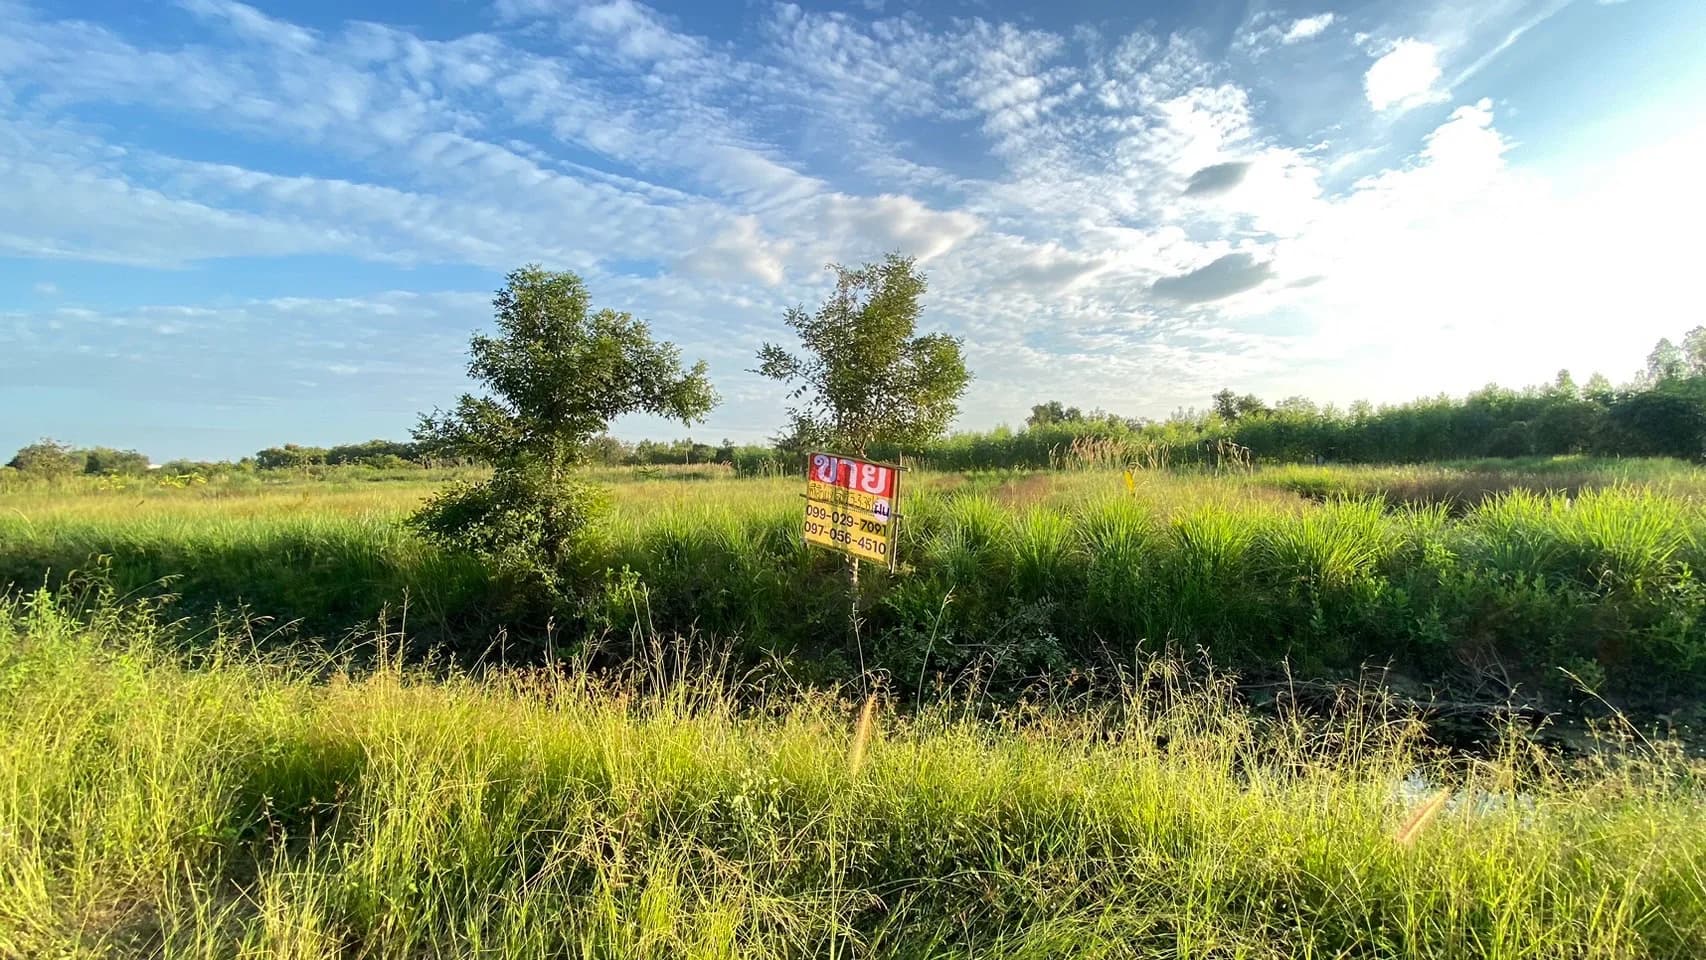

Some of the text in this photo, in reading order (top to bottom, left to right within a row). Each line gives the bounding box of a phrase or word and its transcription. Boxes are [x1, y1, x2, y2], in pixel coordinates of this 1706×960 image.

[814, 455, 887, 494] ขาย
[806, 504, 887, 536] 099-029-7091
[804, 521, 887, 554] 097-056-4510
